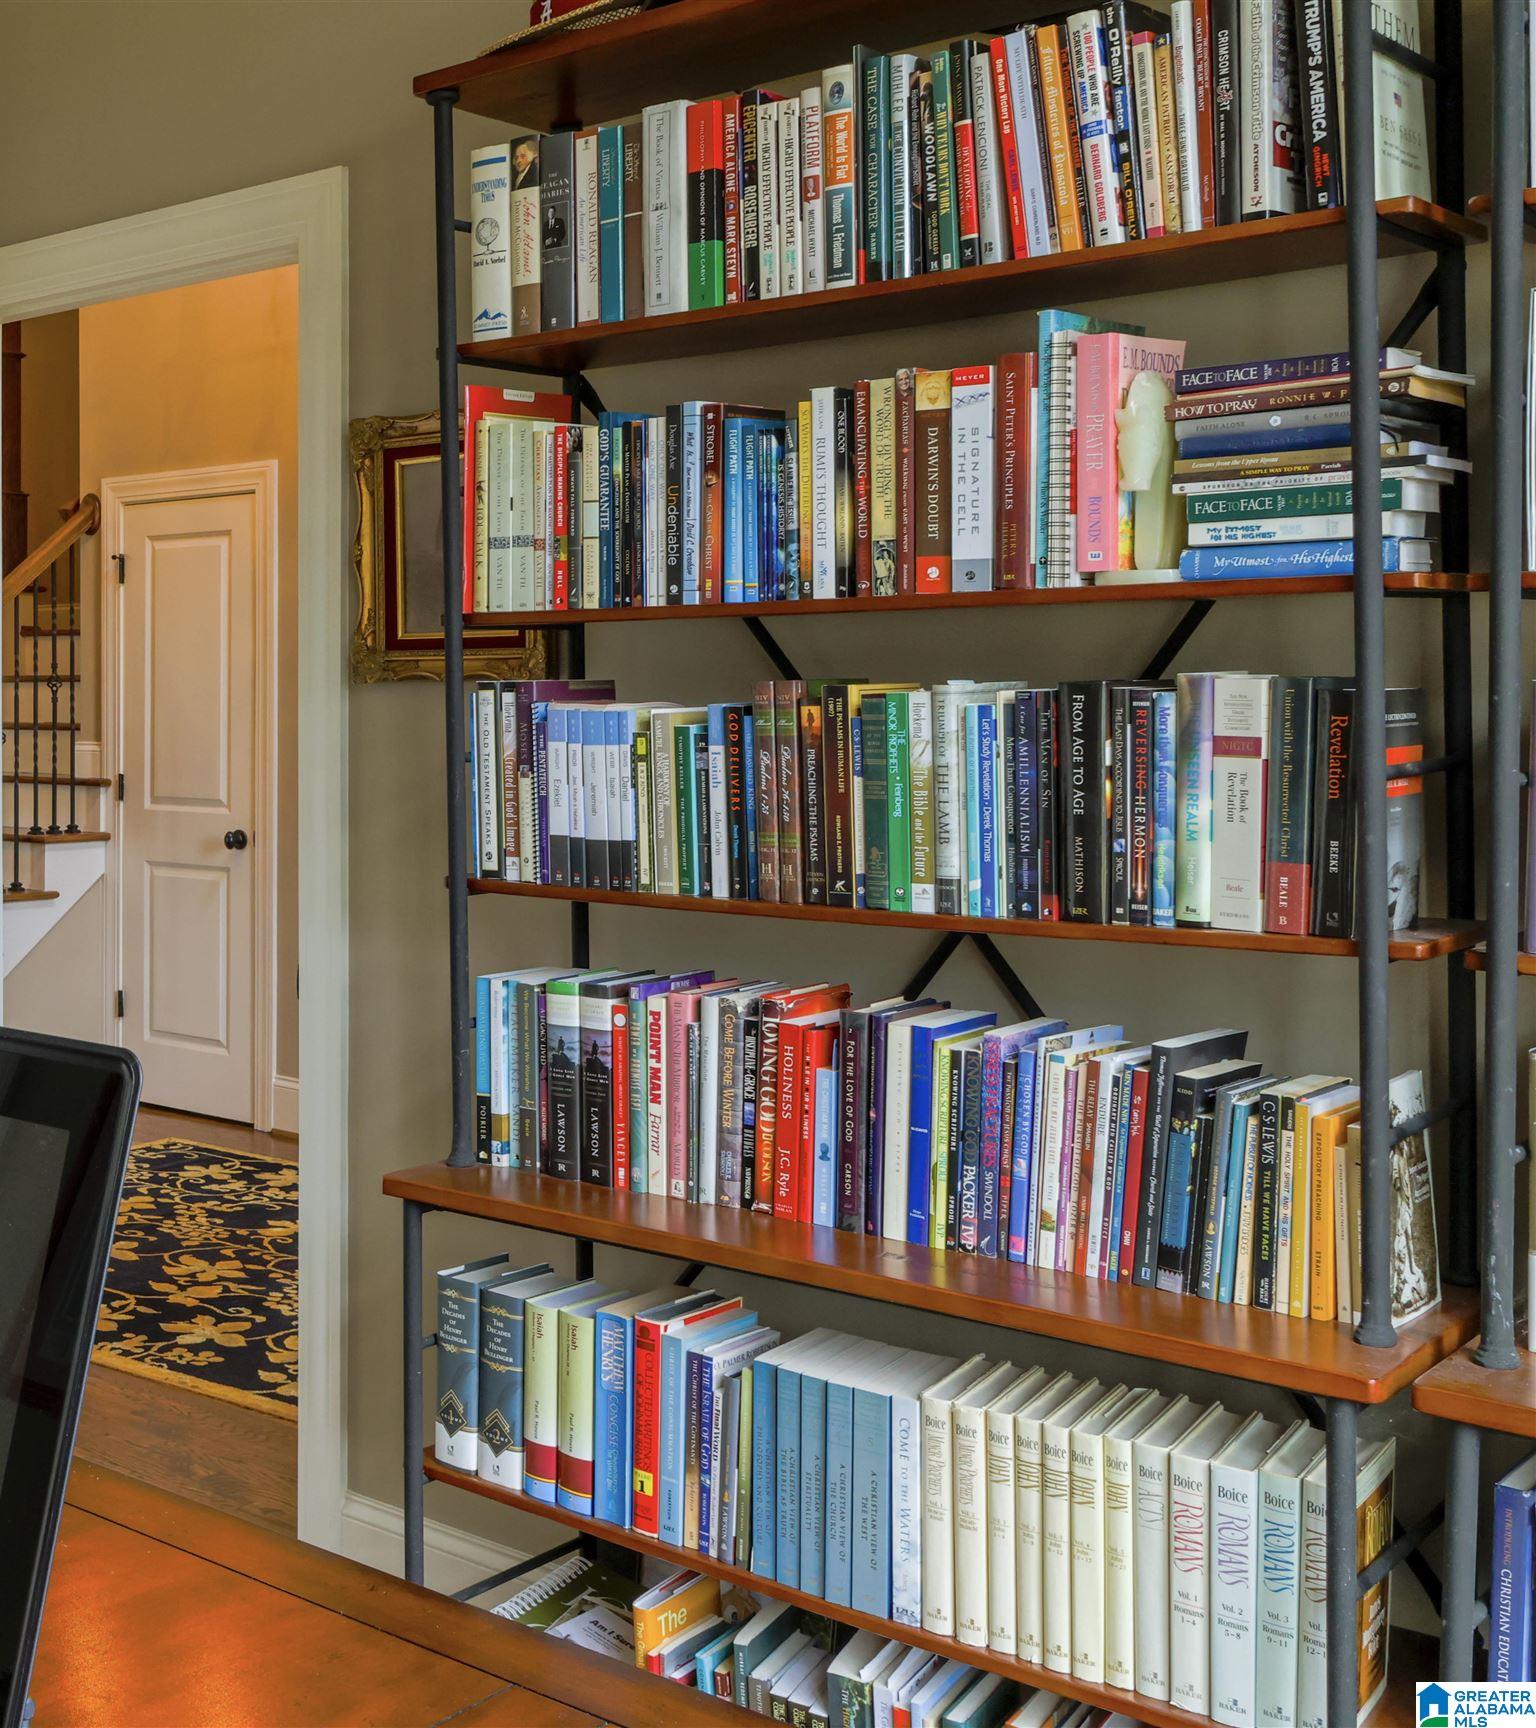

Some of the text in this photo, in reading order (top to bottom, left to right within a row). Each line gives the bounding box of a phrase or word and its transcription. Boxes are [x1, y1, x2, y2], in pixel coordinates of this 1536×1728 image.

[996, 59, 1007, 95] One More
[1072, 30, 1089, 113] SCREWING AMERICA
[1084, 45, 1094, 72] PEOPLE
[1089, 74, 1097, 90] WHO
[1108, 28, 1126, 85] O'Reilly
[1218, 30, 1229, 80] CRIMSON
[1304, 0, 1326, 143] TRUMP'S AMERICA
[806, 105, 820, 169] PLATFORM
[973, 66, 988, 171] PATRICK LENCIONI
[744, 104, 757, 249] EPICENTER ROSENBERG
[836, 116, 847, 180] The World Flat
[867, 68, 878, 229] THE CASE CHARACTER
[924, 123, 937, 202] WOODLAWN
[1252, 144, 1261, 193] ATCHESON
[1313, 146, 1332, 188] NEWT GINGRICH
[725, 114, 738, 278] AMERICA ALONE MARK STEYN
[762, 142, 771, 252] HIGHLY EFFECTIVE PEOPLE
[1090, 144, 1106, 224] BERNARD GOLDBERG
[1121, 162, 1137, 238] BILL O'REILLY
[587, 172, 600, 287] RONALD REAGAN
[807, 209, 816, 258] MICHAEL HYATT
[833, 193, 844, 269] Thomas Friedman
[955, 374, 985, 382] MEYER
[1182, 366, 1258, 386] FACE FACE
[1174, 398, 1258, 419] HOW TO PRAY
[705, 425, 715, 466] STROBEL
[856, 391, 867, 539] EMANCIPATING WORLD
[1005, 373, 1015, 511] SAINT PETER'S PRINCIPLES
[1085, 414, 1105, 472] PRAYER
[599, 428, 610, 531] GOD'S GUARANTEE
[815, 437, 827, 549] RUMI'S THOUGHT
[927, 427, 939, 541] DARWIN'S DOUBT
[958, 427, 966, 537] IN THE CELL
[970, 427, 980, 537] SIGNATURE
[667, 484, 680, 566] Undeniable
[1087, 496, 1102, 543] BOUNDS
[1231, 545, 1355, 570] Utmost Highest
[483, 751, 491, 805] TESTAMENT
[711, 752, 722, 789] Isaiah
[728, 713, 740, 812] GOD DELIVERS
[1071, 695, 1084, 816] FROM AGE TO AGE
[1134, 710, 1148, 859] REVERSING HERMON
[1328, 715, 1349, 800] Revelation
[504, 756, 516, 852] Created in God's Image
[552, 779, 562, 808] Ezekiel
[806, 750, 818, 863] PREACHING THE PSALMS
[937, 764, 951, 846] THE LAMB
[981, 719, 993, 863] Let's Study Revelation Derek Thomas
[1184, 792, 1199, 842] REALM
[1074, 838, 1084, 893] MATHISON
[1329, 840, 1339, 874] BEEKE
[1279, 877, 1289, 908] BEALE
[648, 1009, 662, 1105] POINT MAN
[722, 1013, 735, 1129] COME BEFORE WINTER
[760, 1012, 780, 1131] LOVING GOD
[782, 1045, 794, 1120] HOLINESS
[843, 1039, 856, 1143] FOR THE LOVE OF GOD
[1176, 1087, 1194, 1096] KIDD
[556, 1103, 566, 1154] LAWSON
[591, 1106, 600, 1158] LAWSON
[616, 1123, 625, 1164] YANCEY
[1261, 1101, 1276, 1165] C.S. LEWIS
[778, 1173, 790, 1198] Ryle
[843, 1162, 852, 1197] CARSON
[962, 1165, 976, 1220] PACKER
[983, 1172, 994, 1221] SWINDOLL
[1203, 1239, 1214, 1278] LAWSON
[537, 1313, 545, 1340] Isaiah
[571, 1325, 579, 1351] Isaiah
[898, 1417, 911, 1463] COME
[1016, 1435, 1040, 1453] Boice
[1173, 1474, 1203, 1495] Boice
[1263, 1491, 1295, 1512] Boice
[1173, 1501, 1205, 1577] ROMANS
[1217, 1513, 1252, 1590] ROMANS
[1263, 1519, 1296, 1597] ROMANS
[589, 1619, 605, 1632] Am
[657, 1606, 688, 1637] The
[1217, 1618, 1249, 1632] Romans
[1221, 1604, 1236, 1614] Vol.
[1263, 1624, 1294, 1640] Romans
[1497, 1568, 1512, 1682] CHRISTIAN EDUCAT
